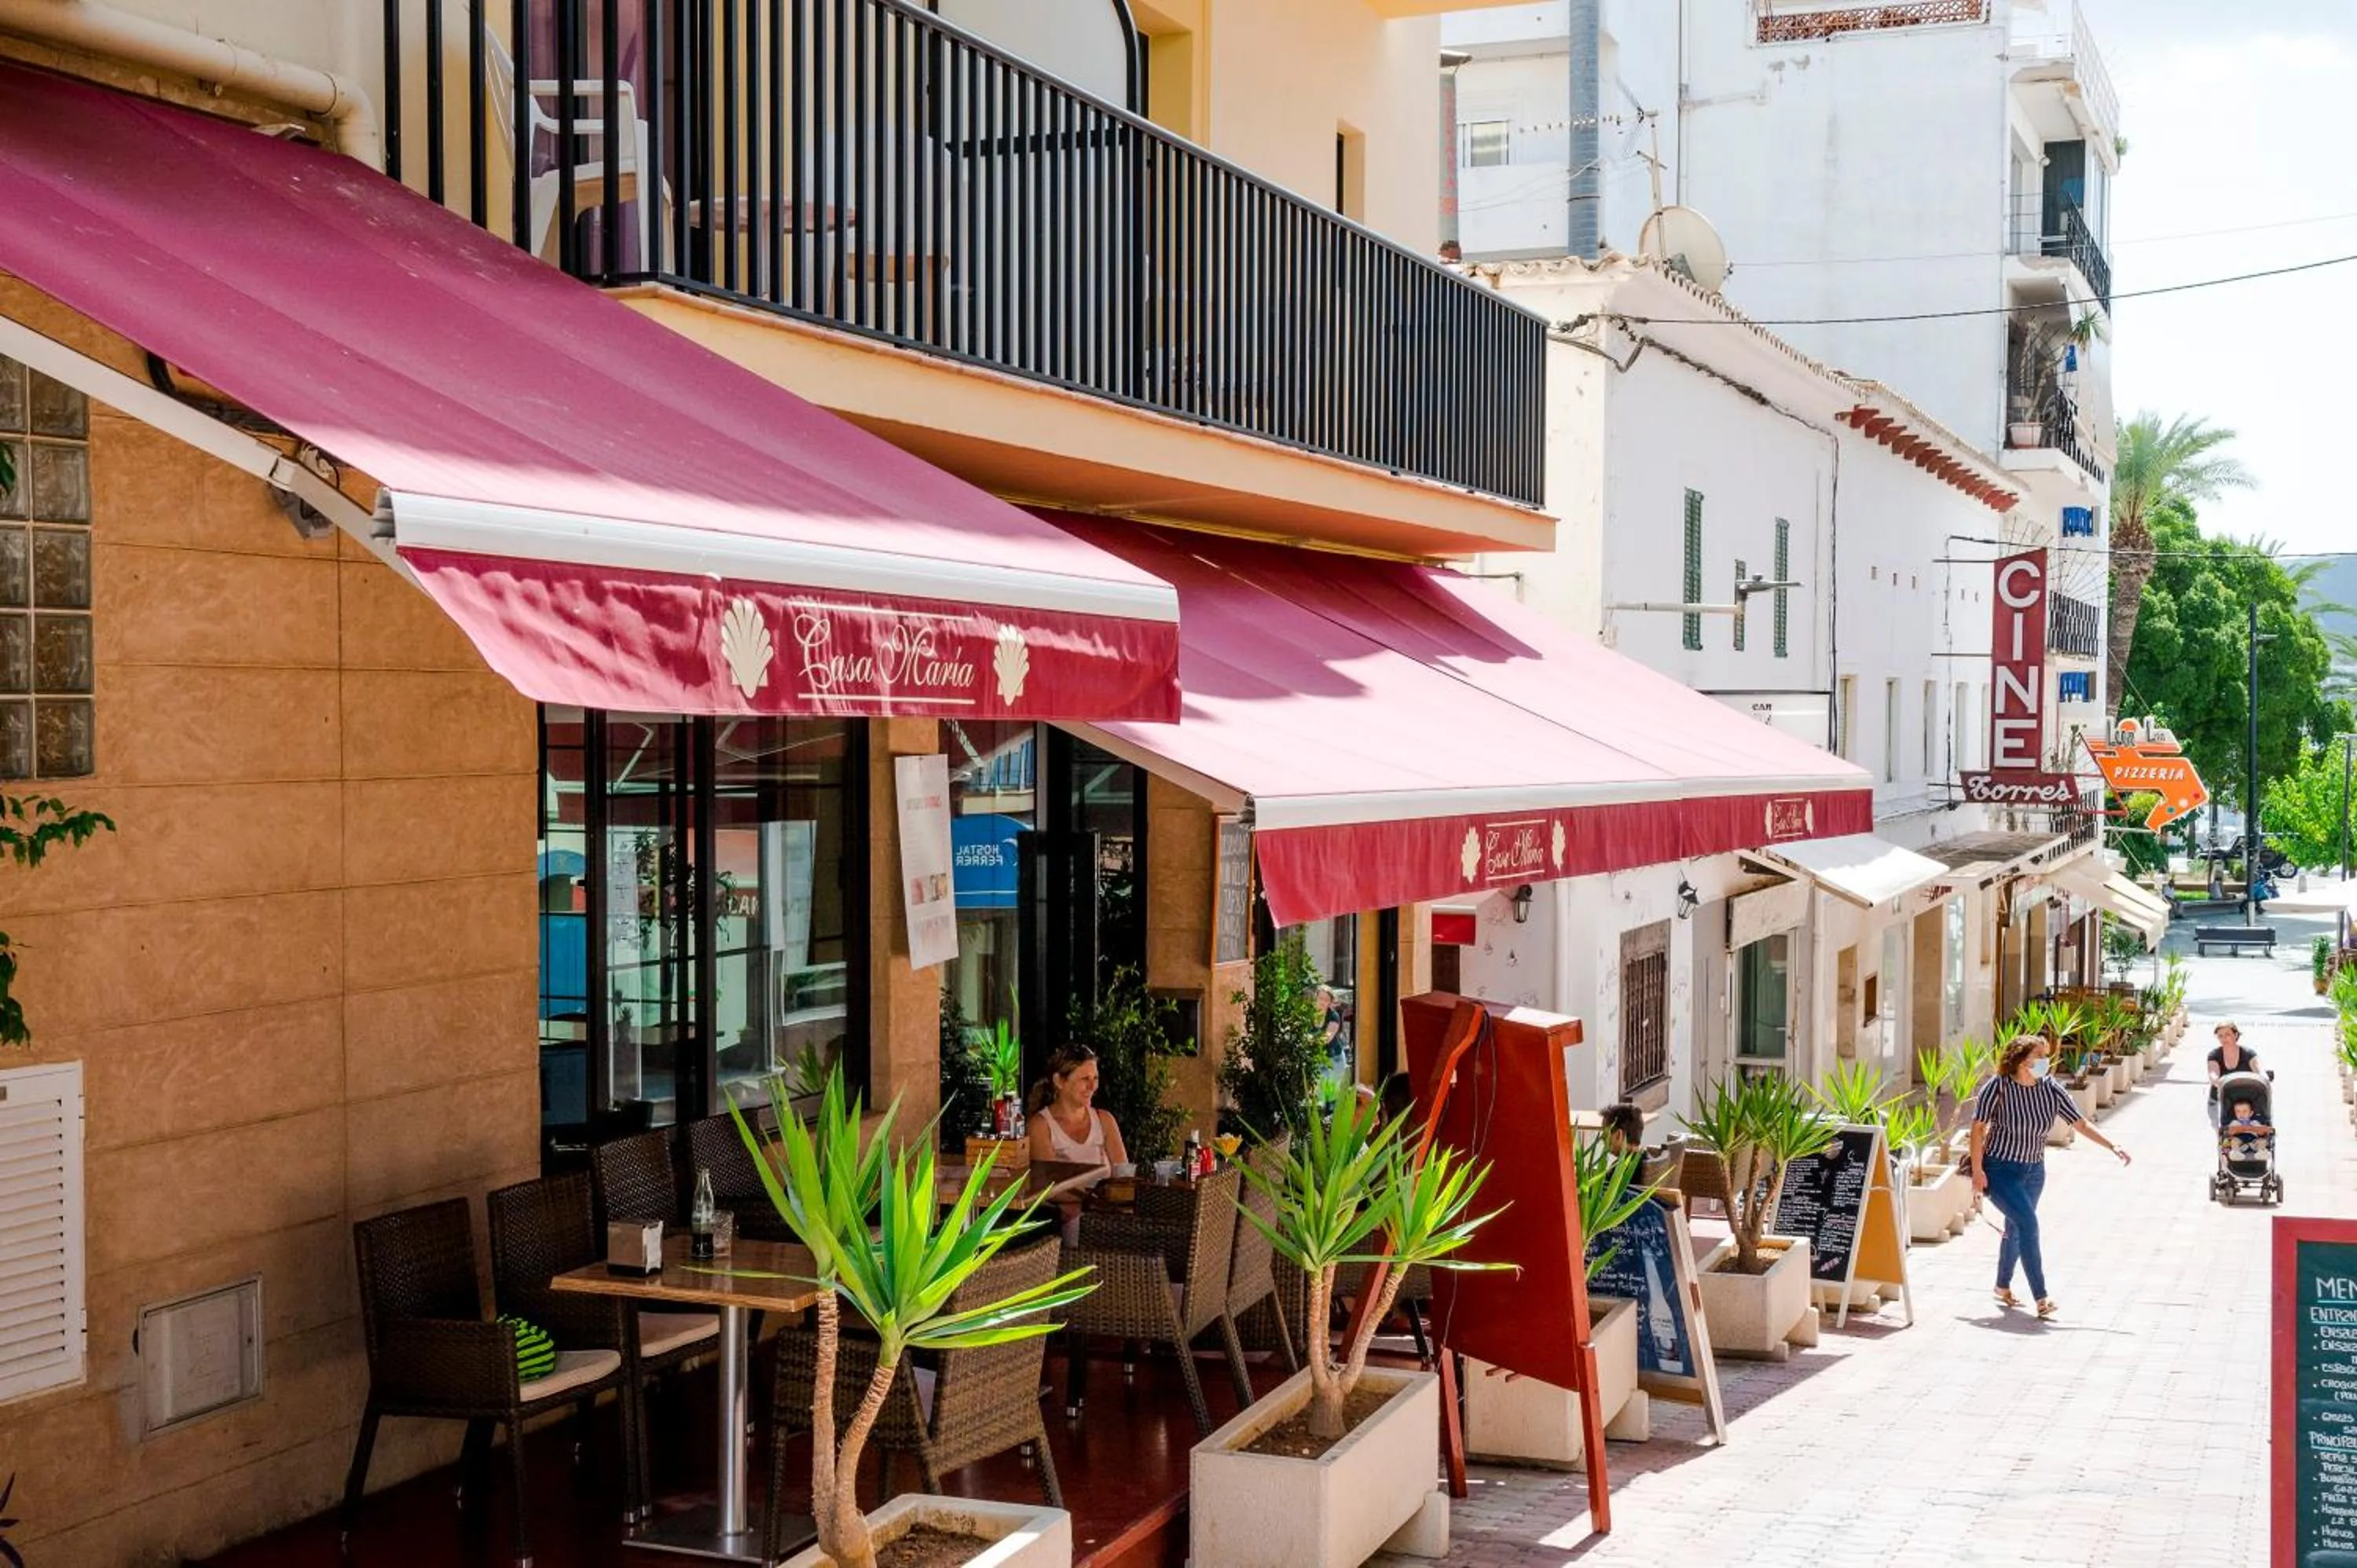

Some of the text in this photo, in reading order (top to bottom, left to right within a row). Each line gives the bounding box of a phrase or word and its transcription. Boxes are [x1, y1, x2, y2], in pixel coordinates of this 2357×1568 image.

[794, 614, 873, 689] Casa
[1995, 559, 2040, 768] CINE
[1967, 775, 2073, 801] Torres
[2113, 766, 2184, 780] PIZZERIA
